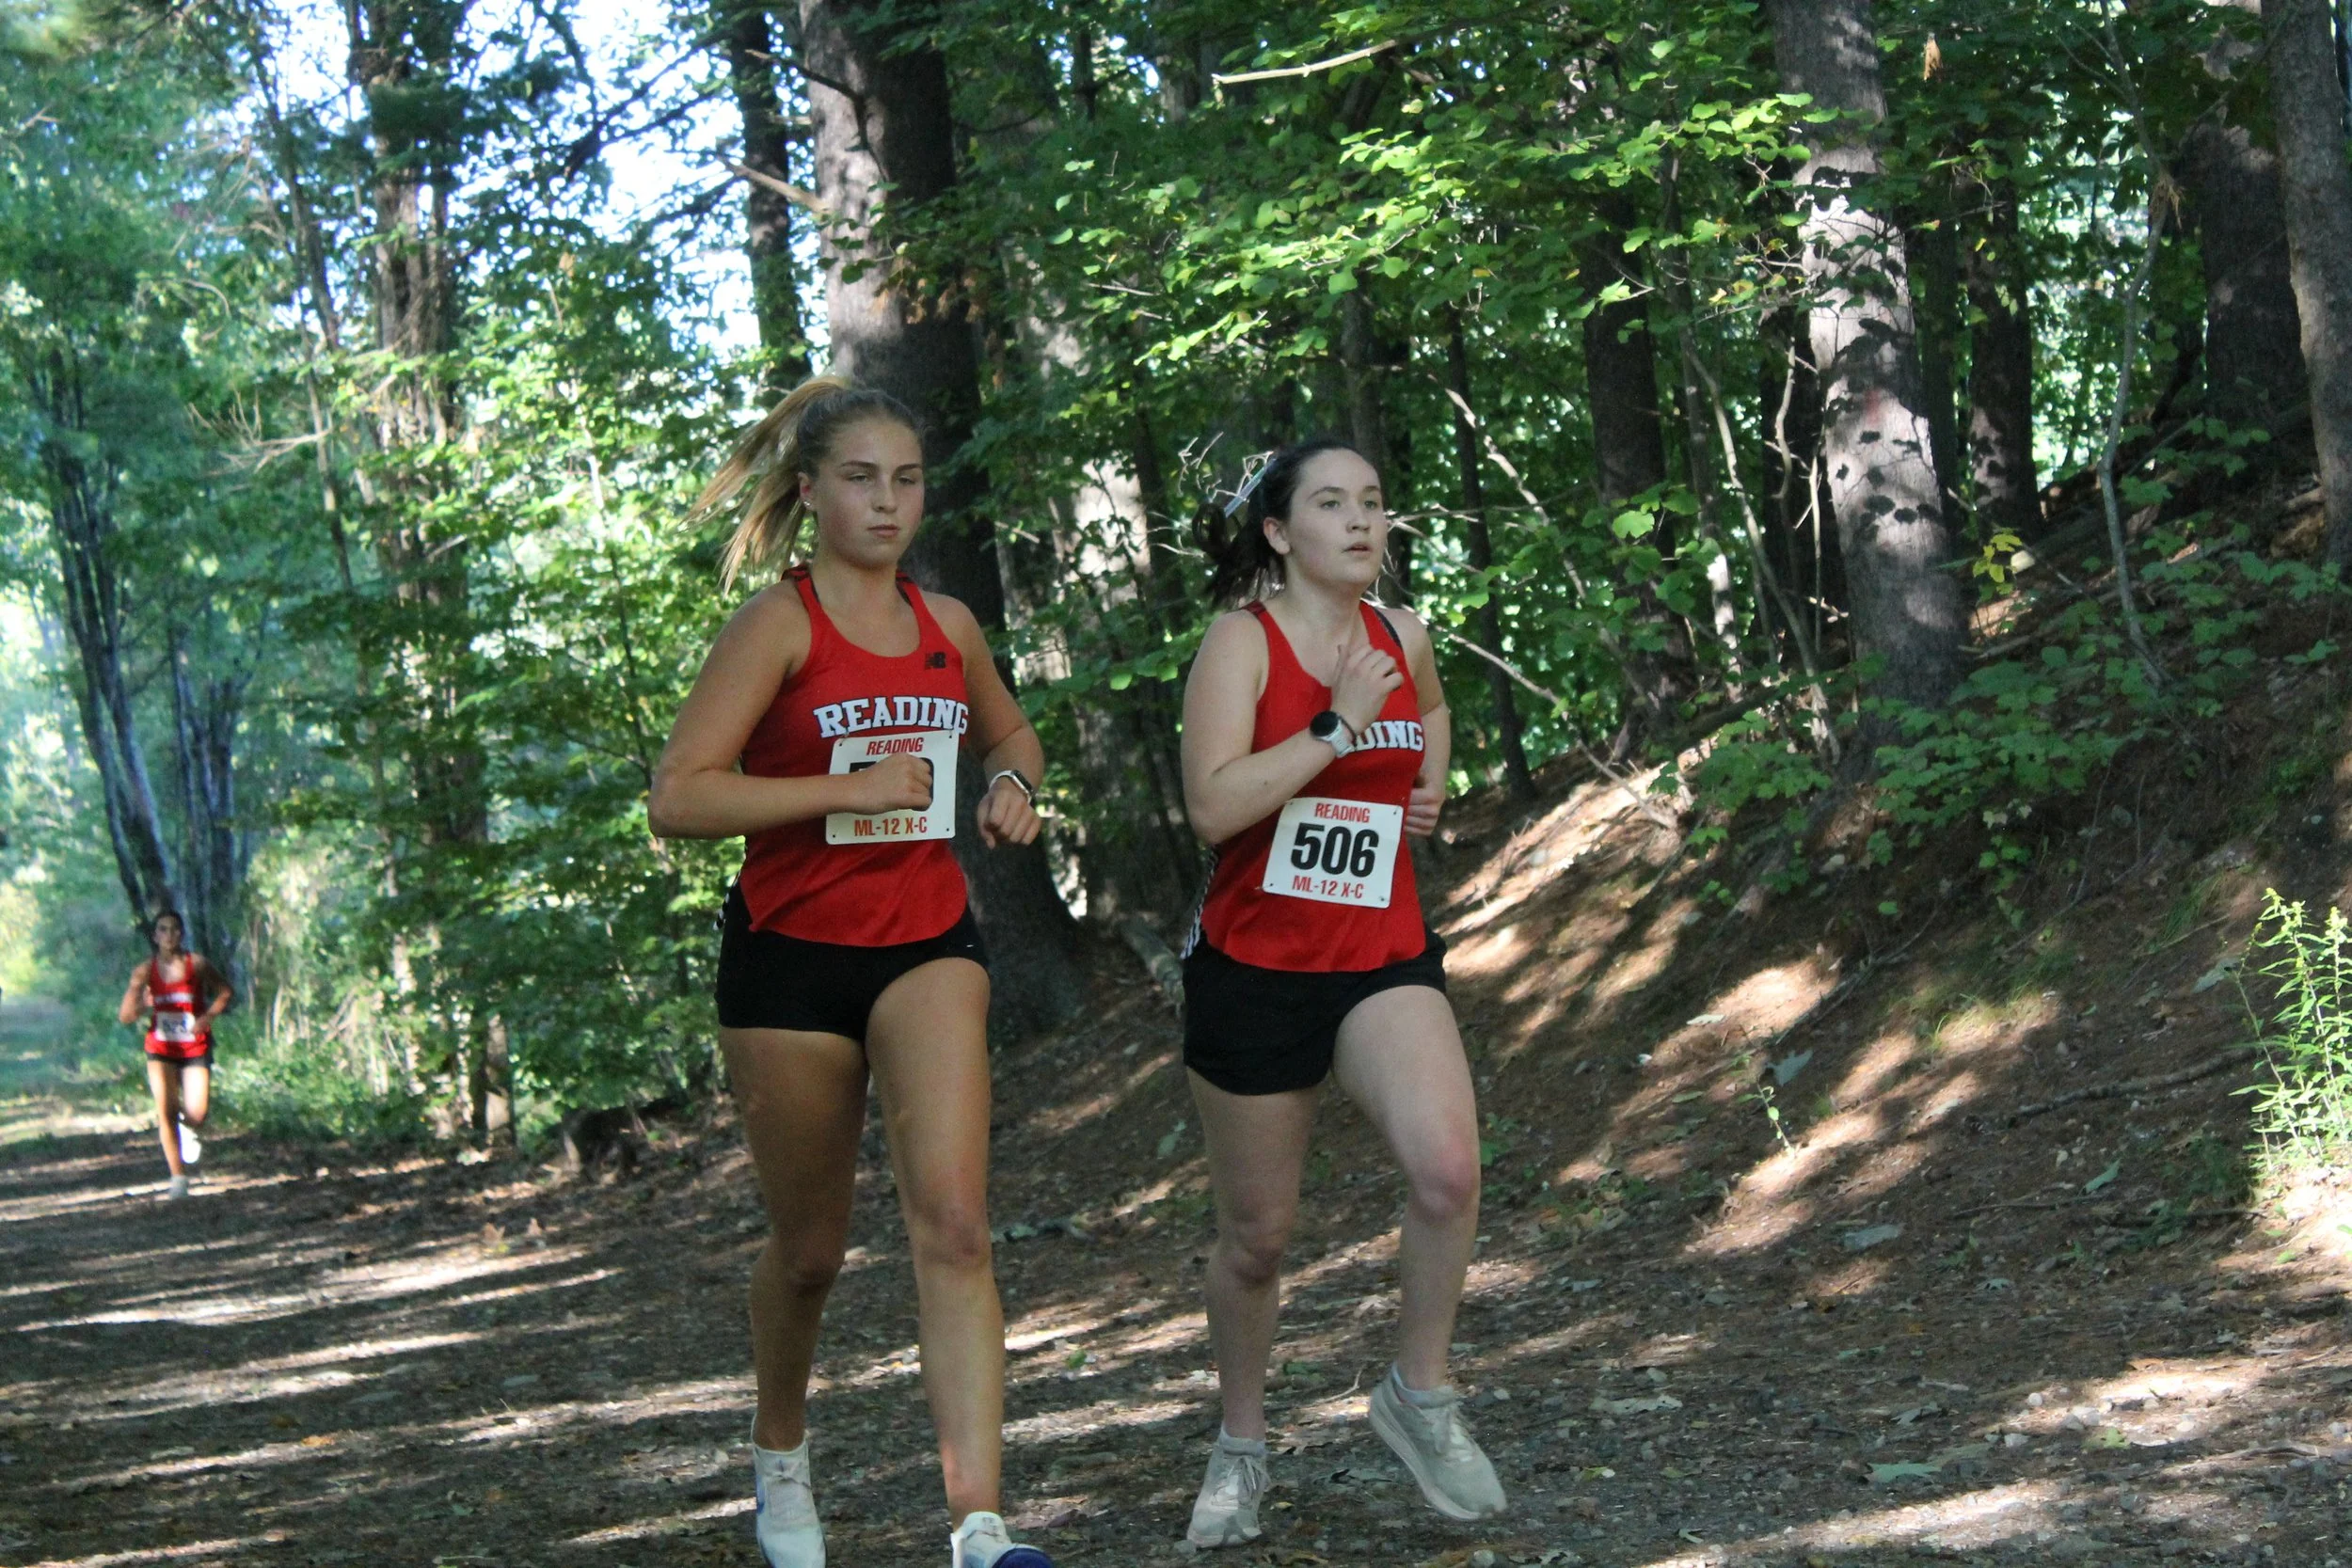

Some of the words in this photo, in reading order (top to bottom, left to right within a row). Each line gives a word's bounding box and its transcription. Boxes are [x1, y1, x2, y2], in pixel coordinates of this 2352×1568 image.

[813, 696, 969, 738] READING
[866, 737, 924, 755] READING
[1355, 721, 1424, 752] DING
[1314, 802, 1371, 823] READING
[854, 817, 900, 836] ML-12
[905, 816, 928, 834] X-C
[1290, 822, 1379, 878] 506
[1292, 875, 1337, 896] ML-12
[1341, 881, 1364, 899] X-C
